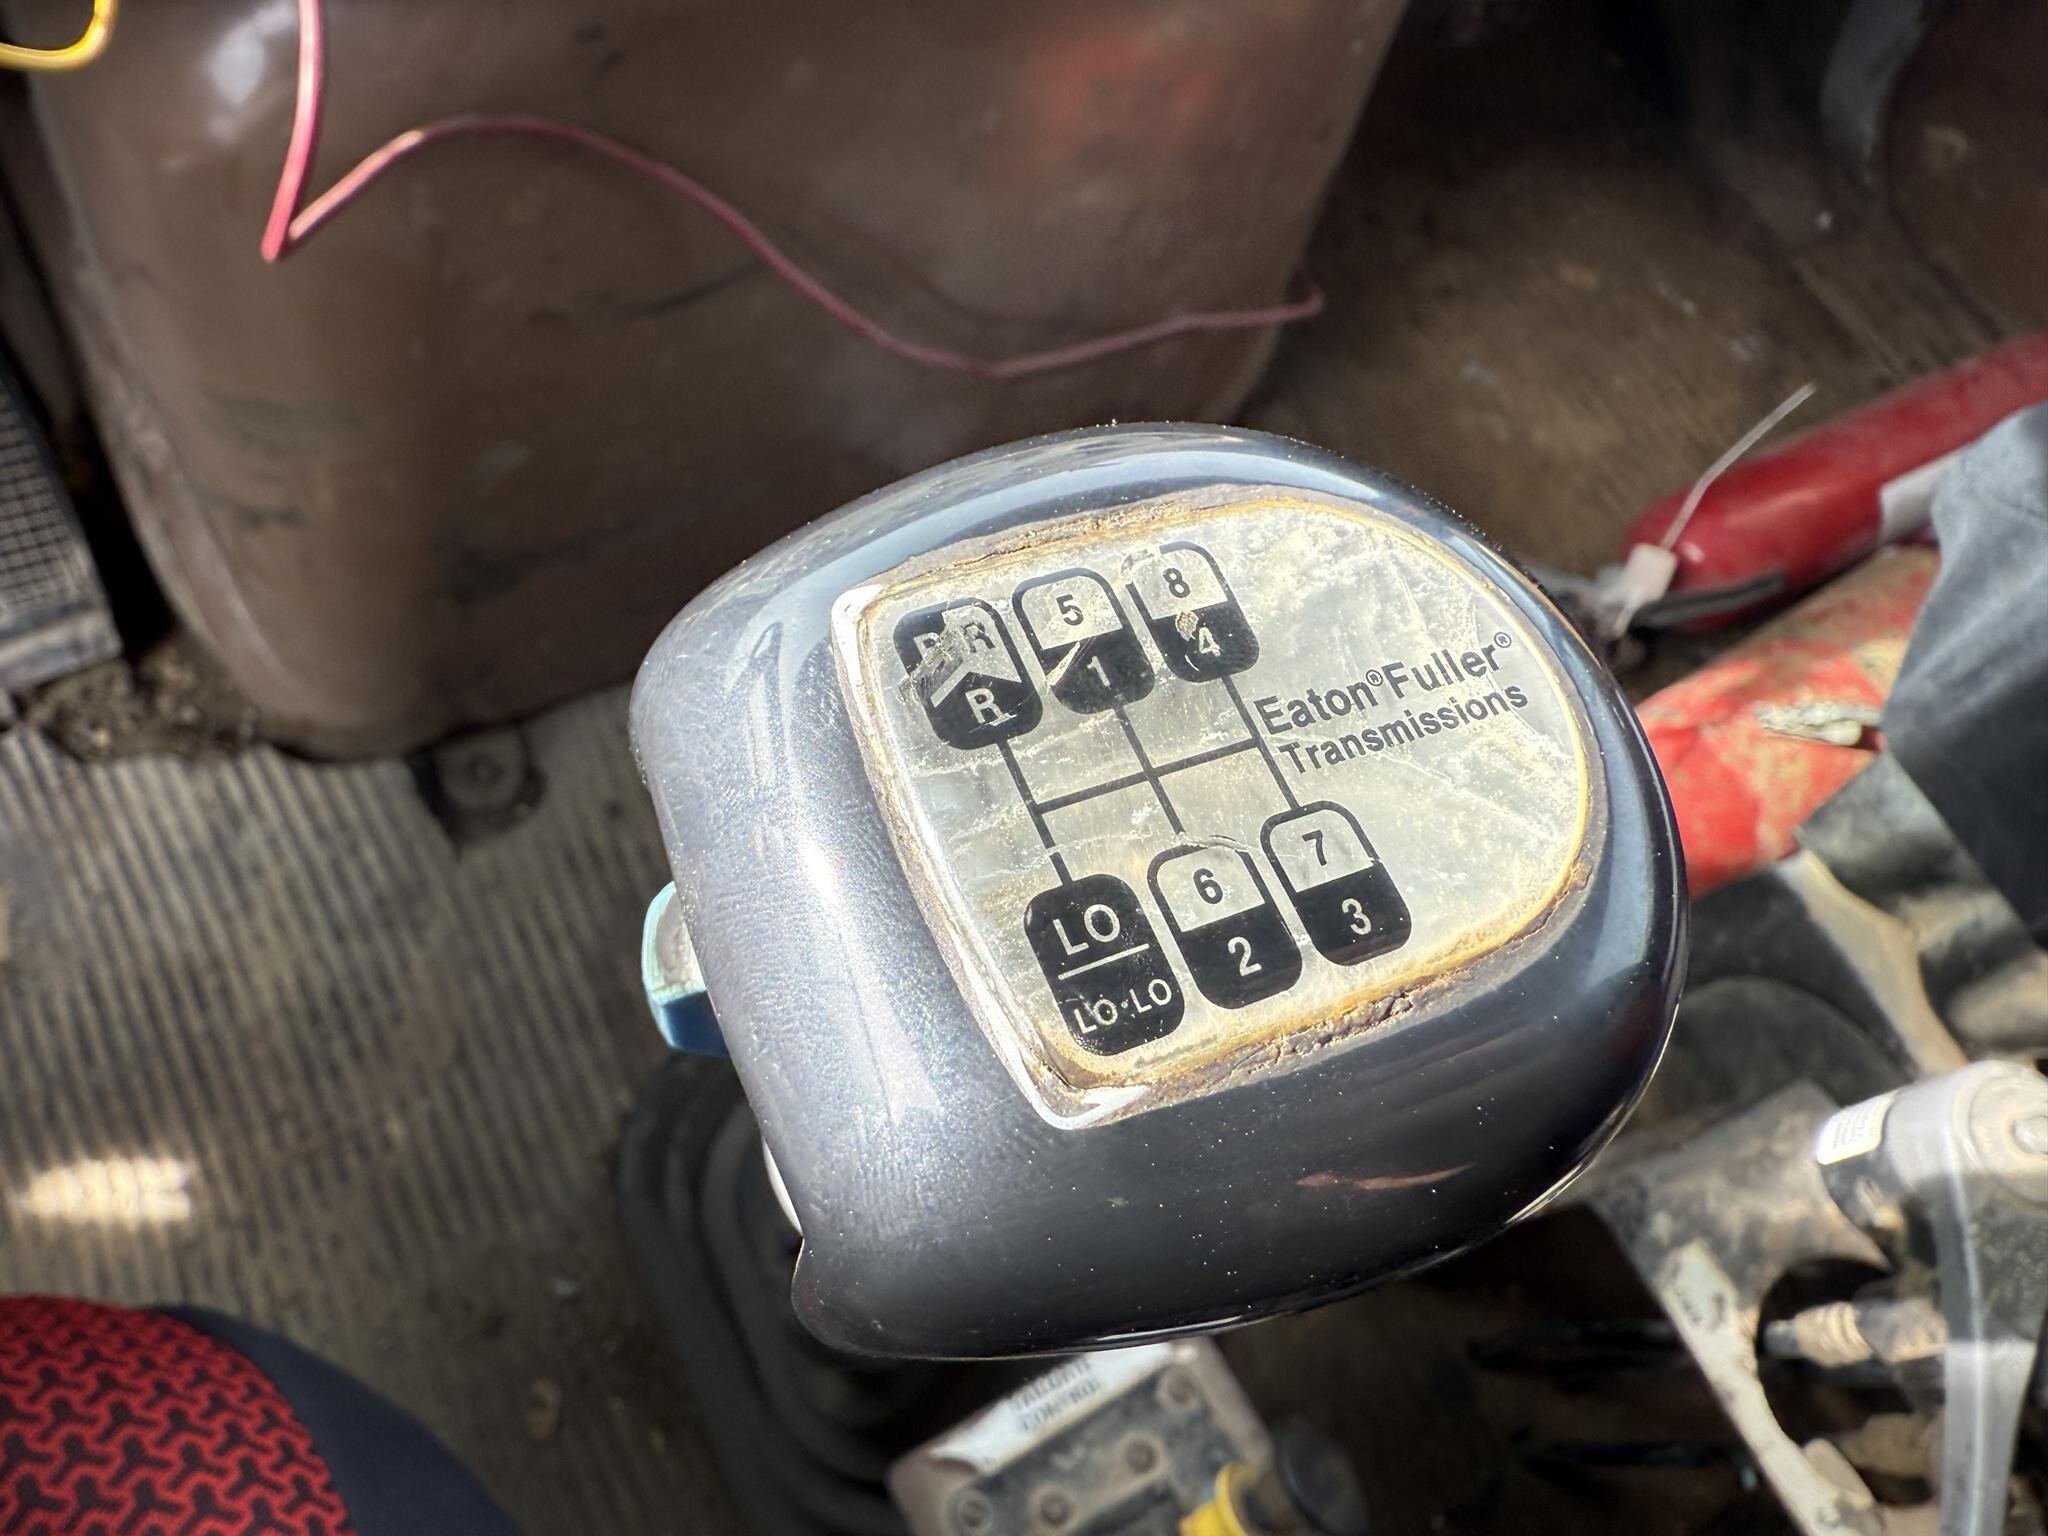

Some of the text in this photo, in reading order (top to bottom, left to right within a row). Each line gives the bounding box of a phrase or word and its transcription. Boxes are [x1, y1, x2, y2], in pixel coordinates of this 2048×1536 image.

[1162, 567, 1191, 598] 8
[1055, 594, 1084, 626] 5
[1198, 627, 1222, 657] 4
[1086, 655, 1112, 688] 1
[965, 687, 1010, 726] R
[1278, 685, 1529, 774] Transmissions
[1301, 829, 1328, 866] 7
[1193, 868, 1224, 904] 6
[1052, 903, 1121, 956] LO
[1341, 898, 1372, 935] 3
[1227, 936, 1262, 977] 2
